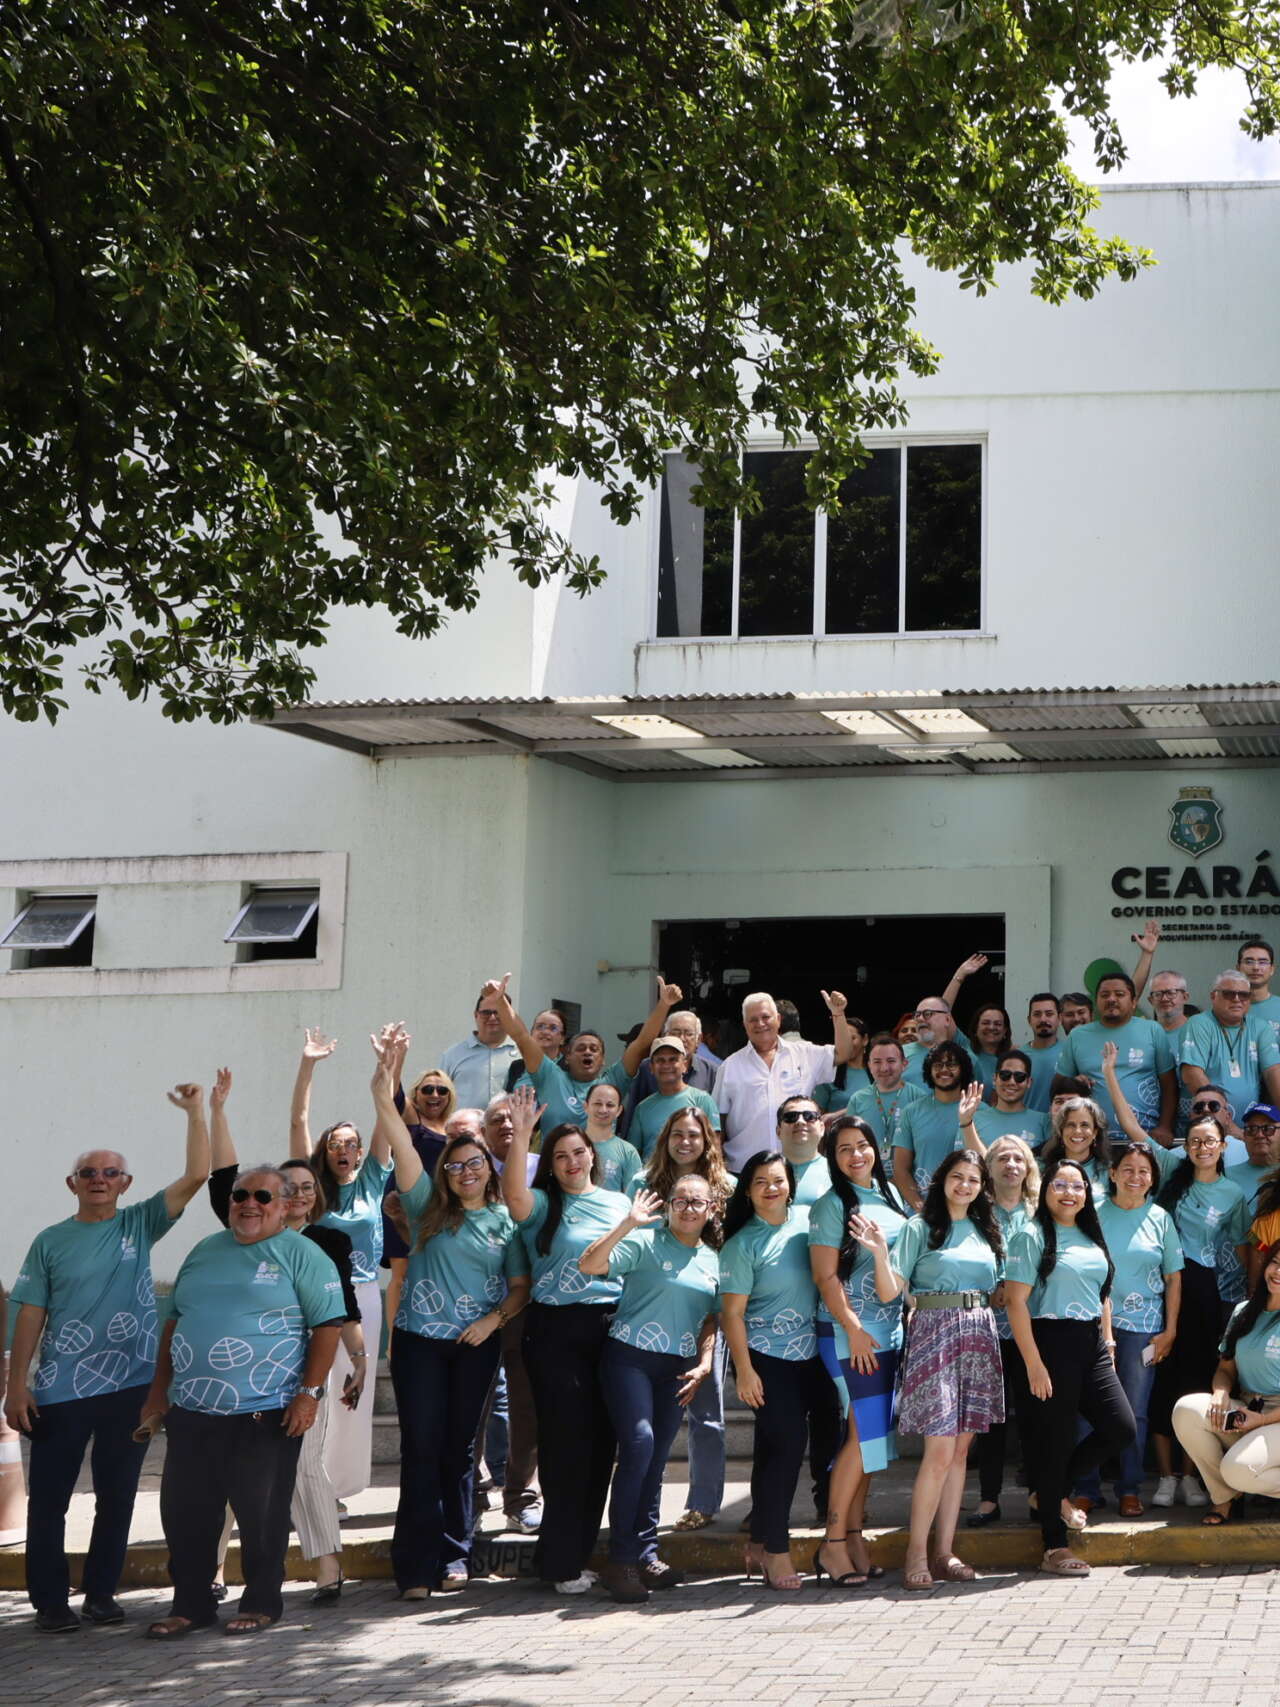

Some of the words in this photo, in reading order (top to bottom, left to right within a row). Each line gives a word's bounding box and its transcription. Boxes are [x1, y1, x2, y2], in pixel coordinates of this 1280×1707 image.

[1111, 905, 1187, 918] GOVERNO
[1192, 904, 1215, 917] DO
[1161, 923, 1214, 931] SECRETARIA
[1216, 923, 1232, 931] DO
